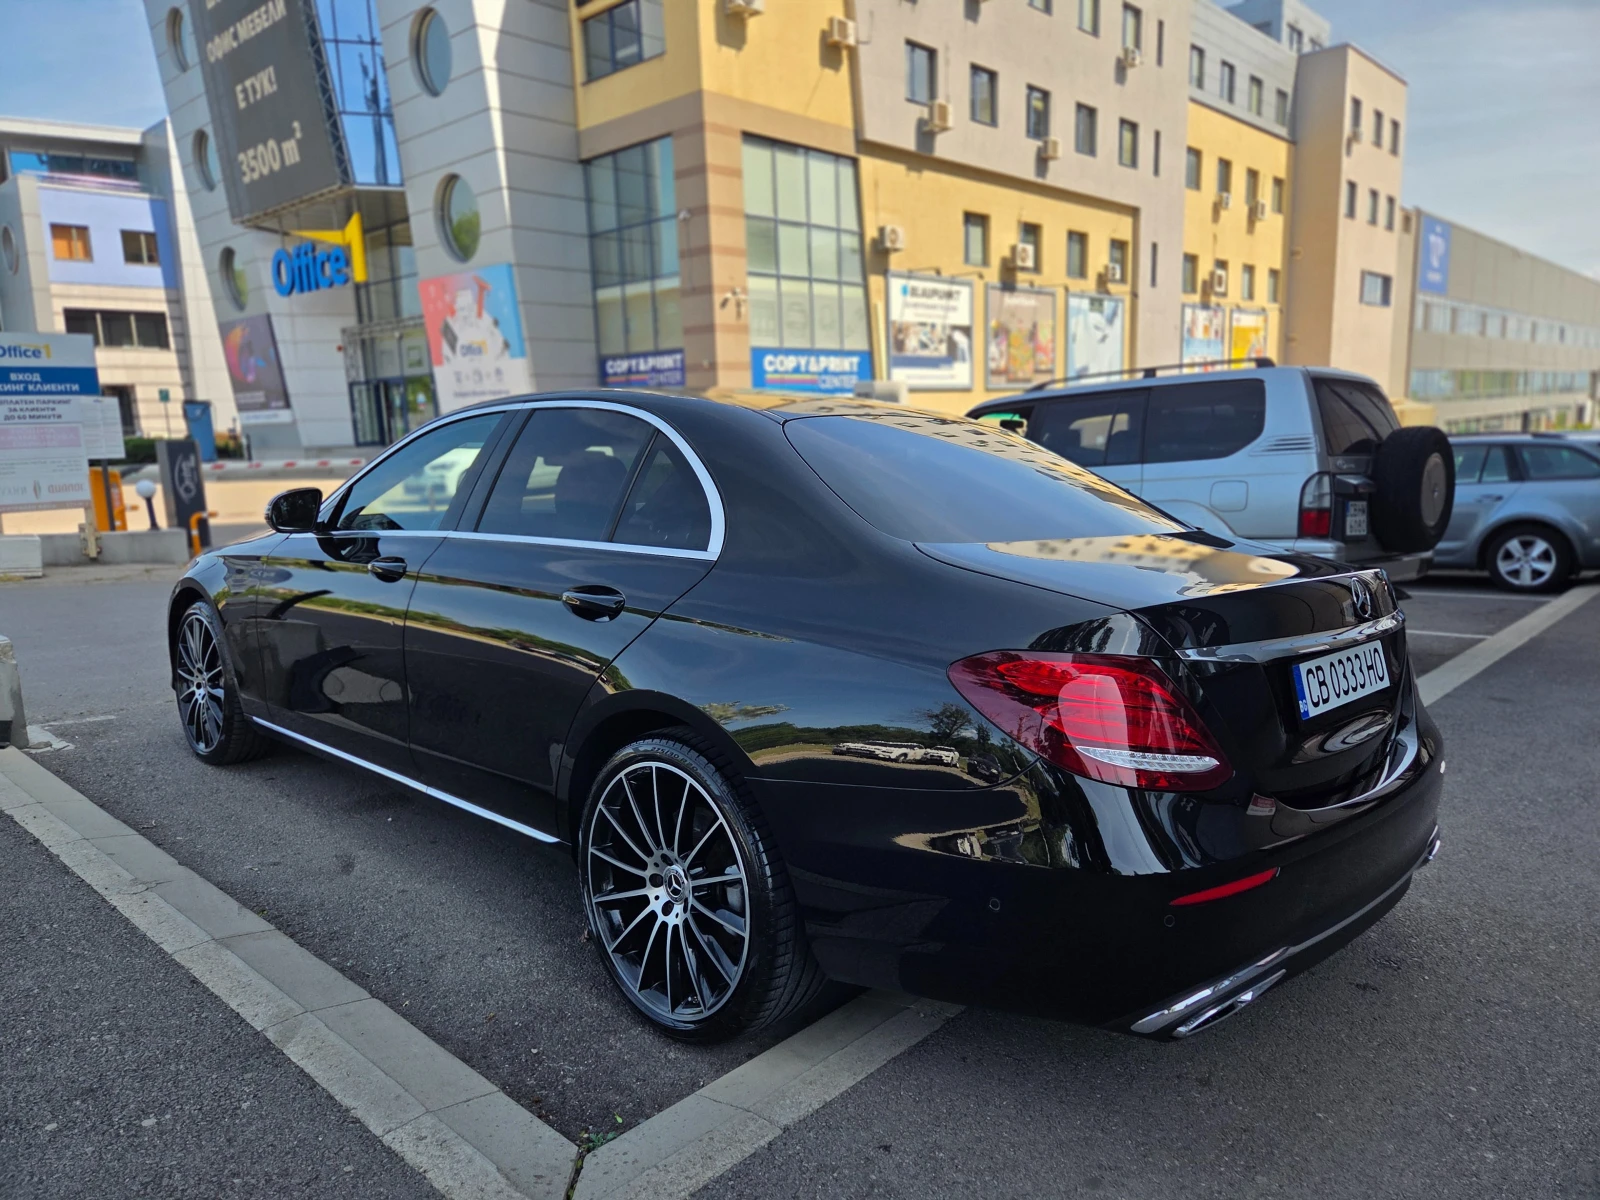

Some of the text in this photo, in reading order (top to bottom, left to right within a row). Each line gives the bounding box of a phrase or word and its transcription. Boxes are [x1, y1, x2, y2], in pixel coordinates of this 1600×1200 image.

[238, 137, 281, 184] 3500
[9, 372, 42, 382] ВХОД
[28, 383, 80, 392] КЛИЕНТИ
[1306, 647, 1385, 708] CB 0333 HO
[1299, 700, 1309, 713] BG
